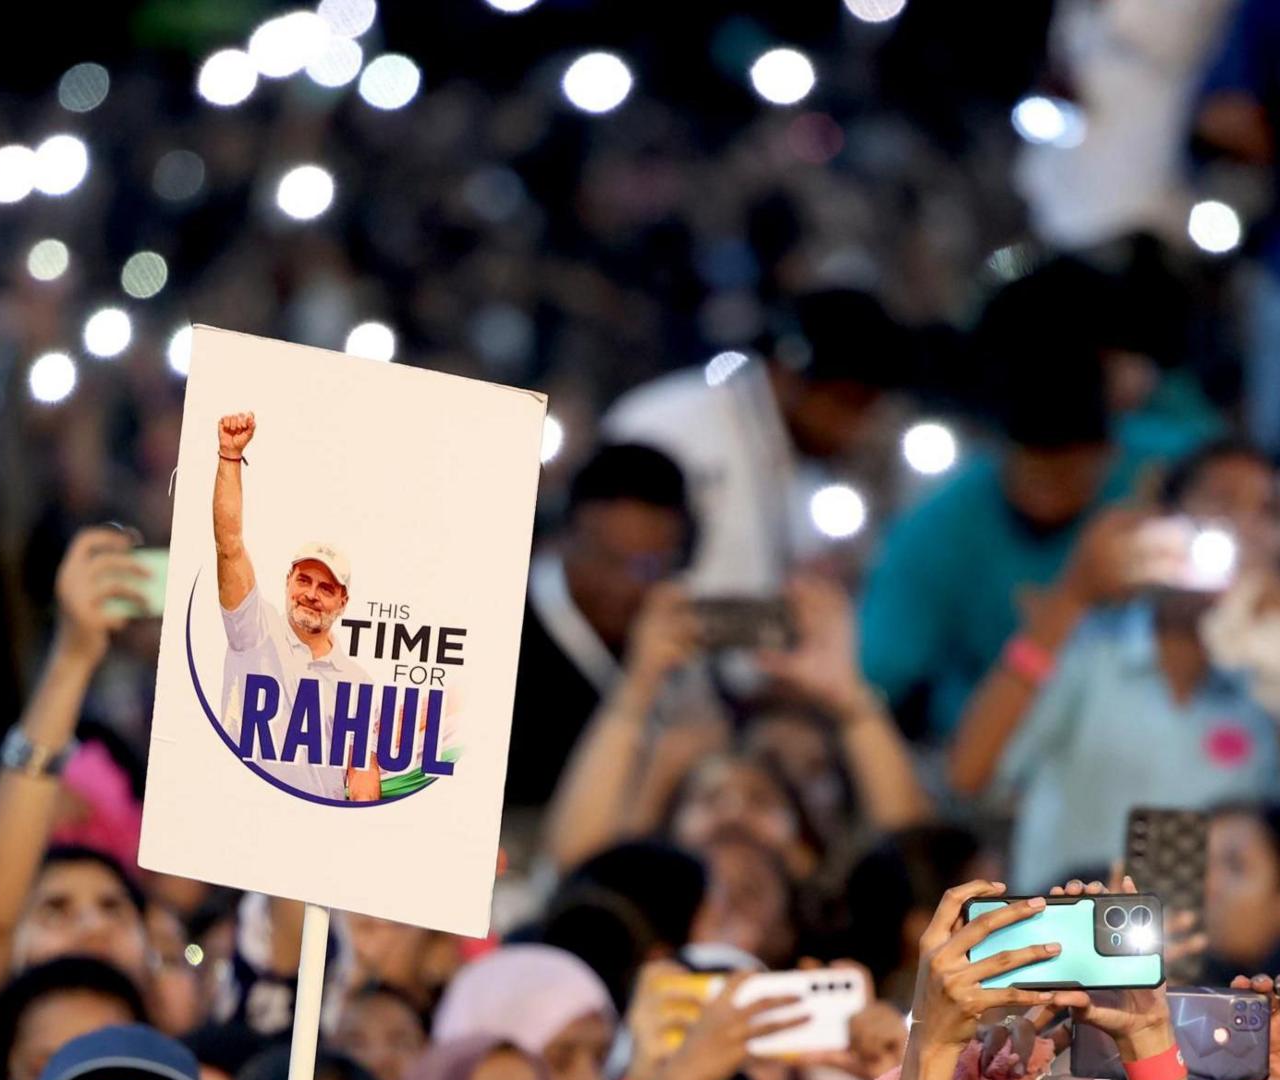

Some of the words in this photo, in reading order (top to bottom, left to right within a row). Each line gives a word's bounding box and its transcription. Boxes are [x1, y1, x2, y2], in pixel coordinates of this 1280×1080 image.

[368, 602, 410, 619] THIS
[341, 619, 467, 665] TIME
[393, 665, 445, 687] FOR
[241, 674, 454, 776] RAHUL
